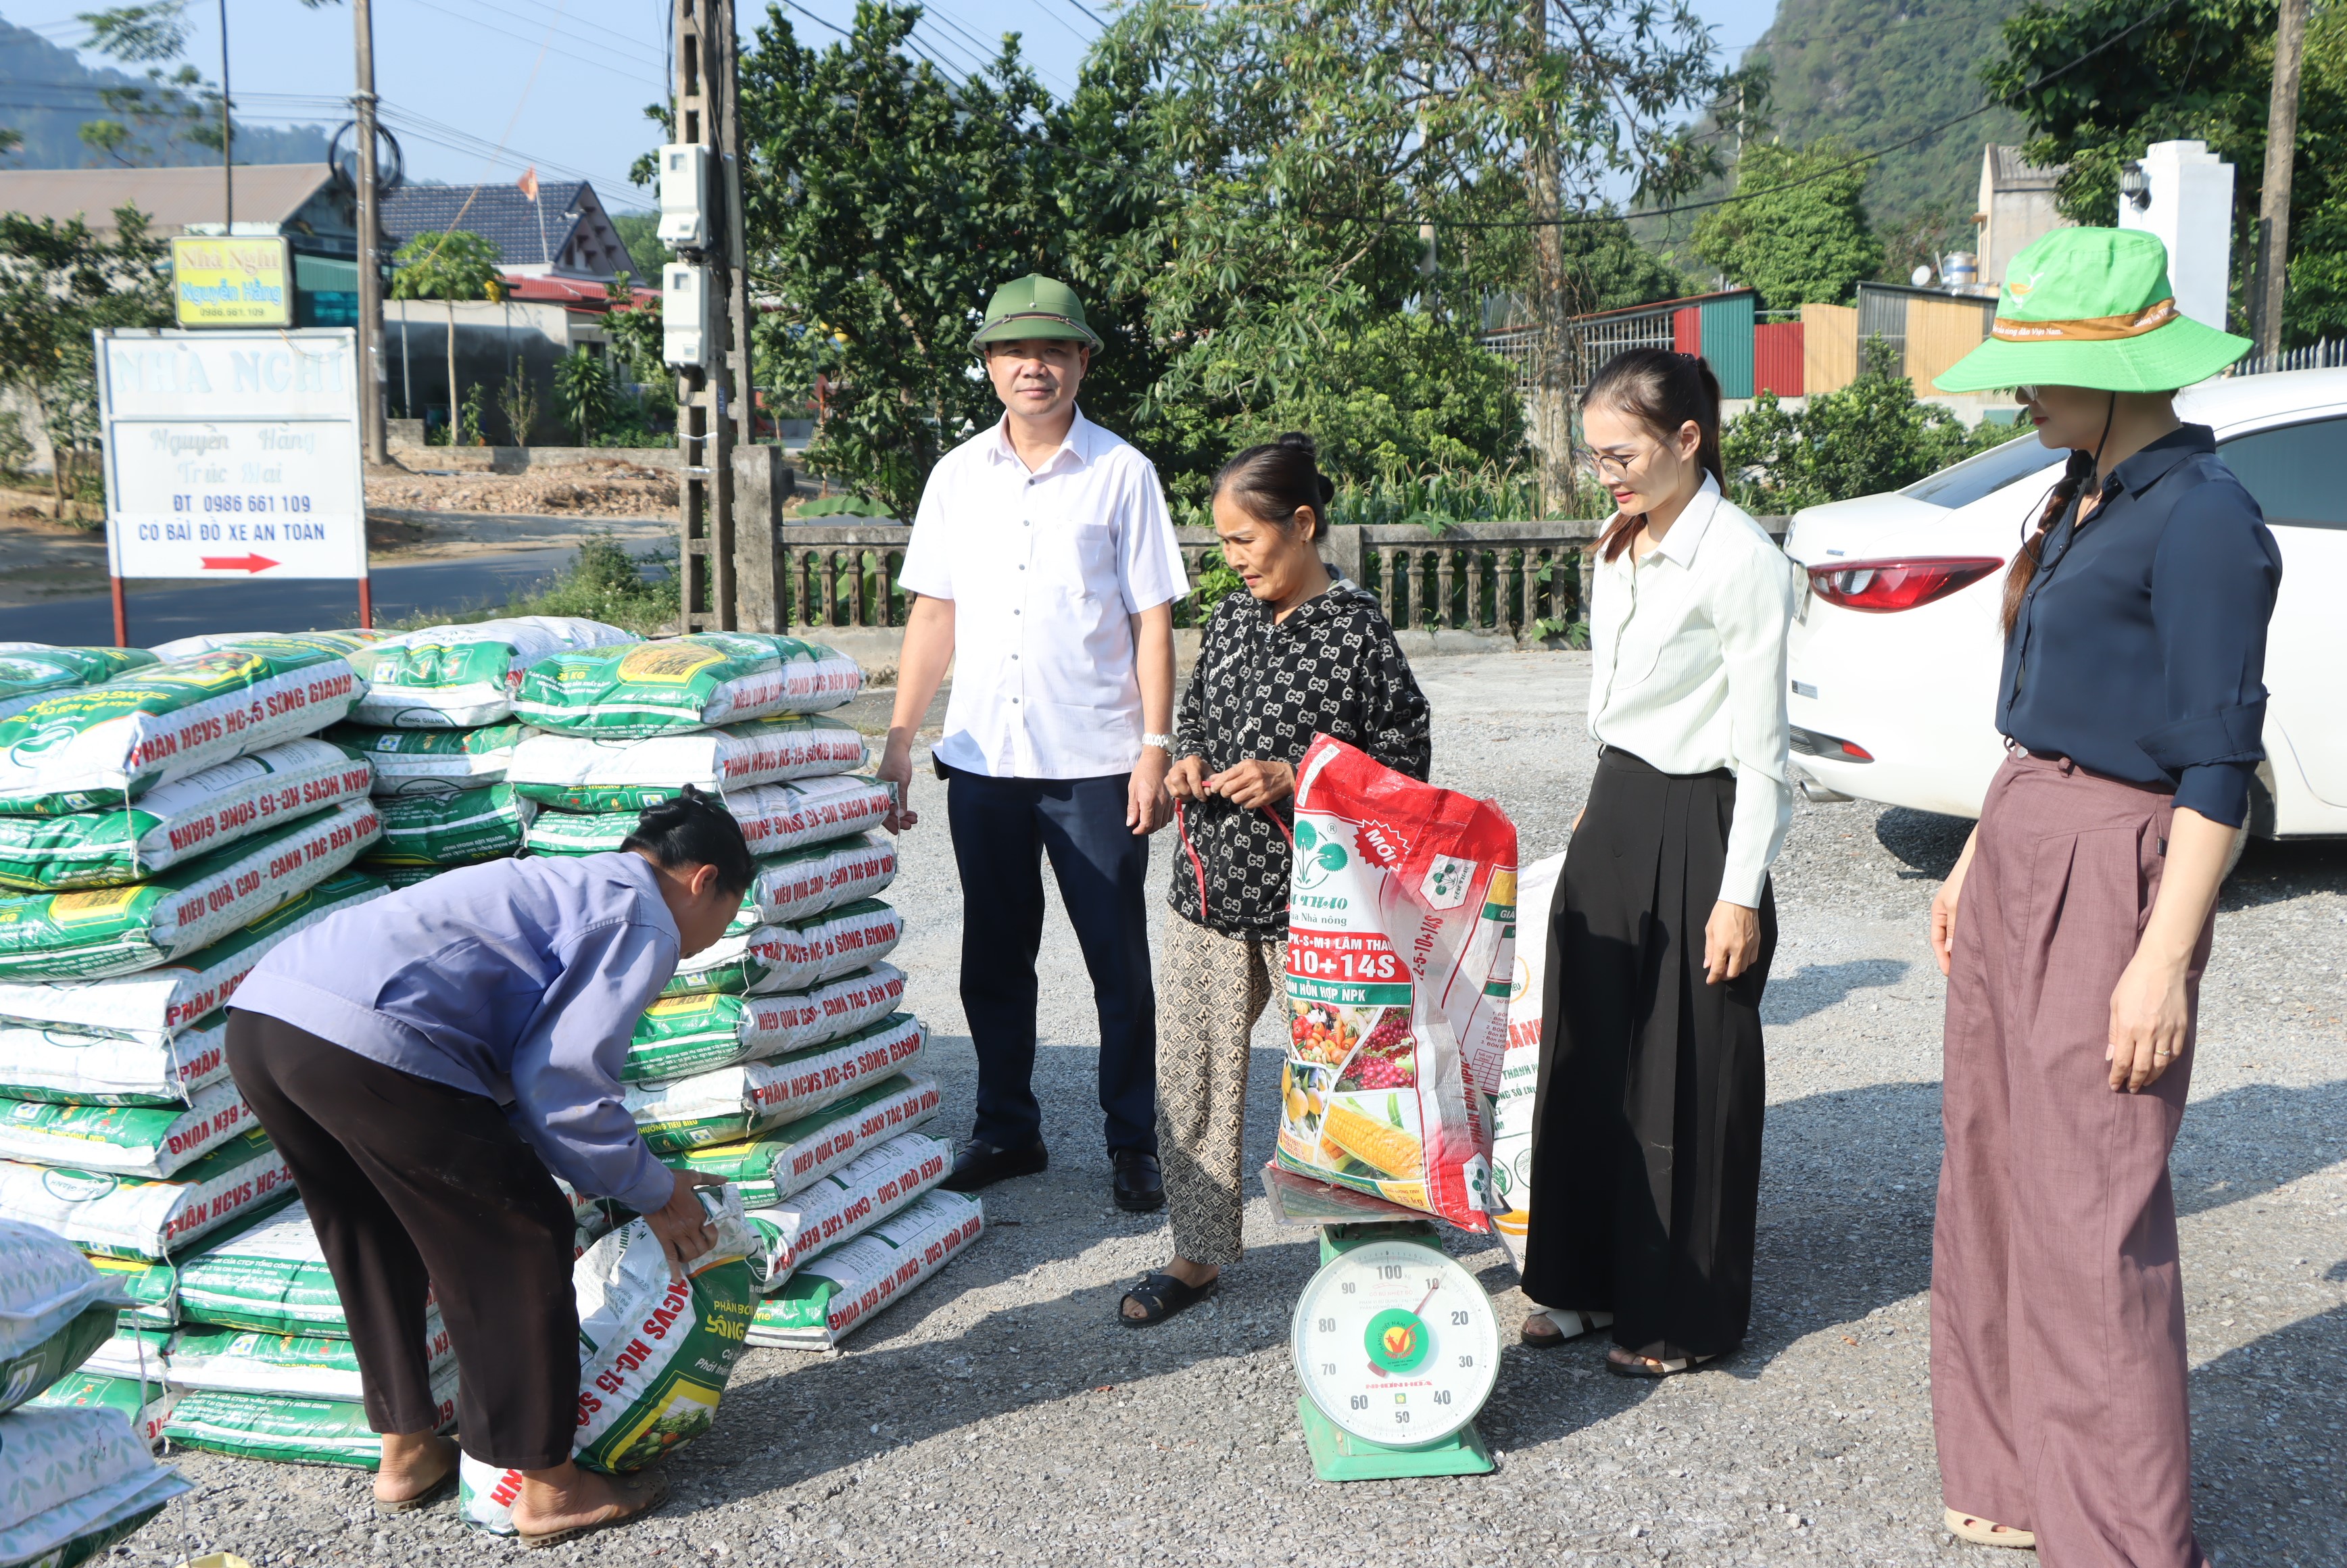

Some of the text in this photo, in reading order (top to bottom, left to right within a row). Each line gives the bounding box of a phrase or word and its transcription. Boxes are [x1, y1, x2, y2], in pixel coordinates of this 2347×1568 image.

[180, 246, 224, 269] Nhà
[113, 342, 212, 393] NHÀ
[172, 495, 310, 512] ĐT 0986 661 109
[138, 519, 159, 541] CÓ
[228, 523, 248, 541] XE
[253, 523, 274, 541] AN
[283, 520, 324, 541] TOÀN
[558, 671, 586, 681] 25 KG
[180, 716, 221, 749] HCVS
[309, 674, 352, 703] GIANH
[752, 750, 776, 771] HCVS
[832, 743, 861, 760] GIANH
[169, 775, 339, 850] HCVS HC-15 SÔNG GIANH
[805, 804, 838, 828] HC-15
[839, 798, 868, 820] HCVS
[1365, 828, 1397, 862] MỚI
[177, 824, 352, 927] HIỆU QUẢ CAO CANH TÁC BỀN
[793, 876, 808, 901] QUẢ
[810, 876, 823, 893] CAO
[848, 861, 864, 881] TÁC
[865, 855, 879, 877] BỀN
[1301, 895, 1348, 910] THAO
[1301, 913, 1347, 927] Nhà nông
[835, 931, 863, 953] SÔNG
[1335, 937, 1361, 950] LÂM
[1300, 980, 1365, 1002] HỖN HỢP NPK
[166, 989, 214, 1026] PHÂN
[758, 984, 886, 1033] HIỆU QUẢ CANH TÁC BỀN
[176, 1048, 220, 1081] PHÂN
[752, 1033, 920, 1105] PHÂN HCVS HC-15 SÔNG GIANH
[1503, 1066, 1530, 1079] THÀNH
[1465, 1087, 1484, 1144] PHÂN BÓN
[168, 1104, 238, 1154] BỀN VỮNG
[792, 1151, 813, 1177] HIỆU
[816, 1137, 833, 1165] QUẢ
[833, 1130, 854, 1153] CAO
[861, 1114, 884, 1138] CANH
[888, 1105, 902, 1126] TÁC
[904, 1095, 919, 1119] BỀN
[921, 1155, 943, 1182] HIỆU
[877, 1181, 898, 1204] CAO
[900, 1169, 920, 1193] QUẢ
[212, 1181, 251, 1217] HCVS
[1412, 1196, 1423, 1206] kg
[963, 1216, 981, 1238] HIỆU
[942, 1226, 962, 1252] QUẢ
[924, 1242, 943, 1265] CAO
[895, 1257, 920, 1288] CANH
[1376, 1265, 1402, 1279] 100
[1426, 1277, 1440, 1290] 10
[878, 1275, 897, 1299] TÁC
[1341, 1282, 1356, 1294] 90
[643, 1278, 689, 1341] HCVS
[714, 1300, 736, 1313] PHÂN
[860, 1288, 879, 1314] BỀN
[704, 1313, 745, 1341] SÔNG
[827, 1301, 861, 1331] VỮNG
[1319, 1317, 1336, 1333] 80
[1451, 1310, 1470, 1326] 20
[597, 1339, 652, 1394] HC-15
[695, 1358, 717, 1372] Phát
[1322, 1363, 1336, 1375] 70
[1459, 1355, 1473, 1368] 30
[1351, 1394, 1368, 1411] 60
[1434, 1390, 1451, 1405] 40
[1395, 1411, 1410, 1423] 50
